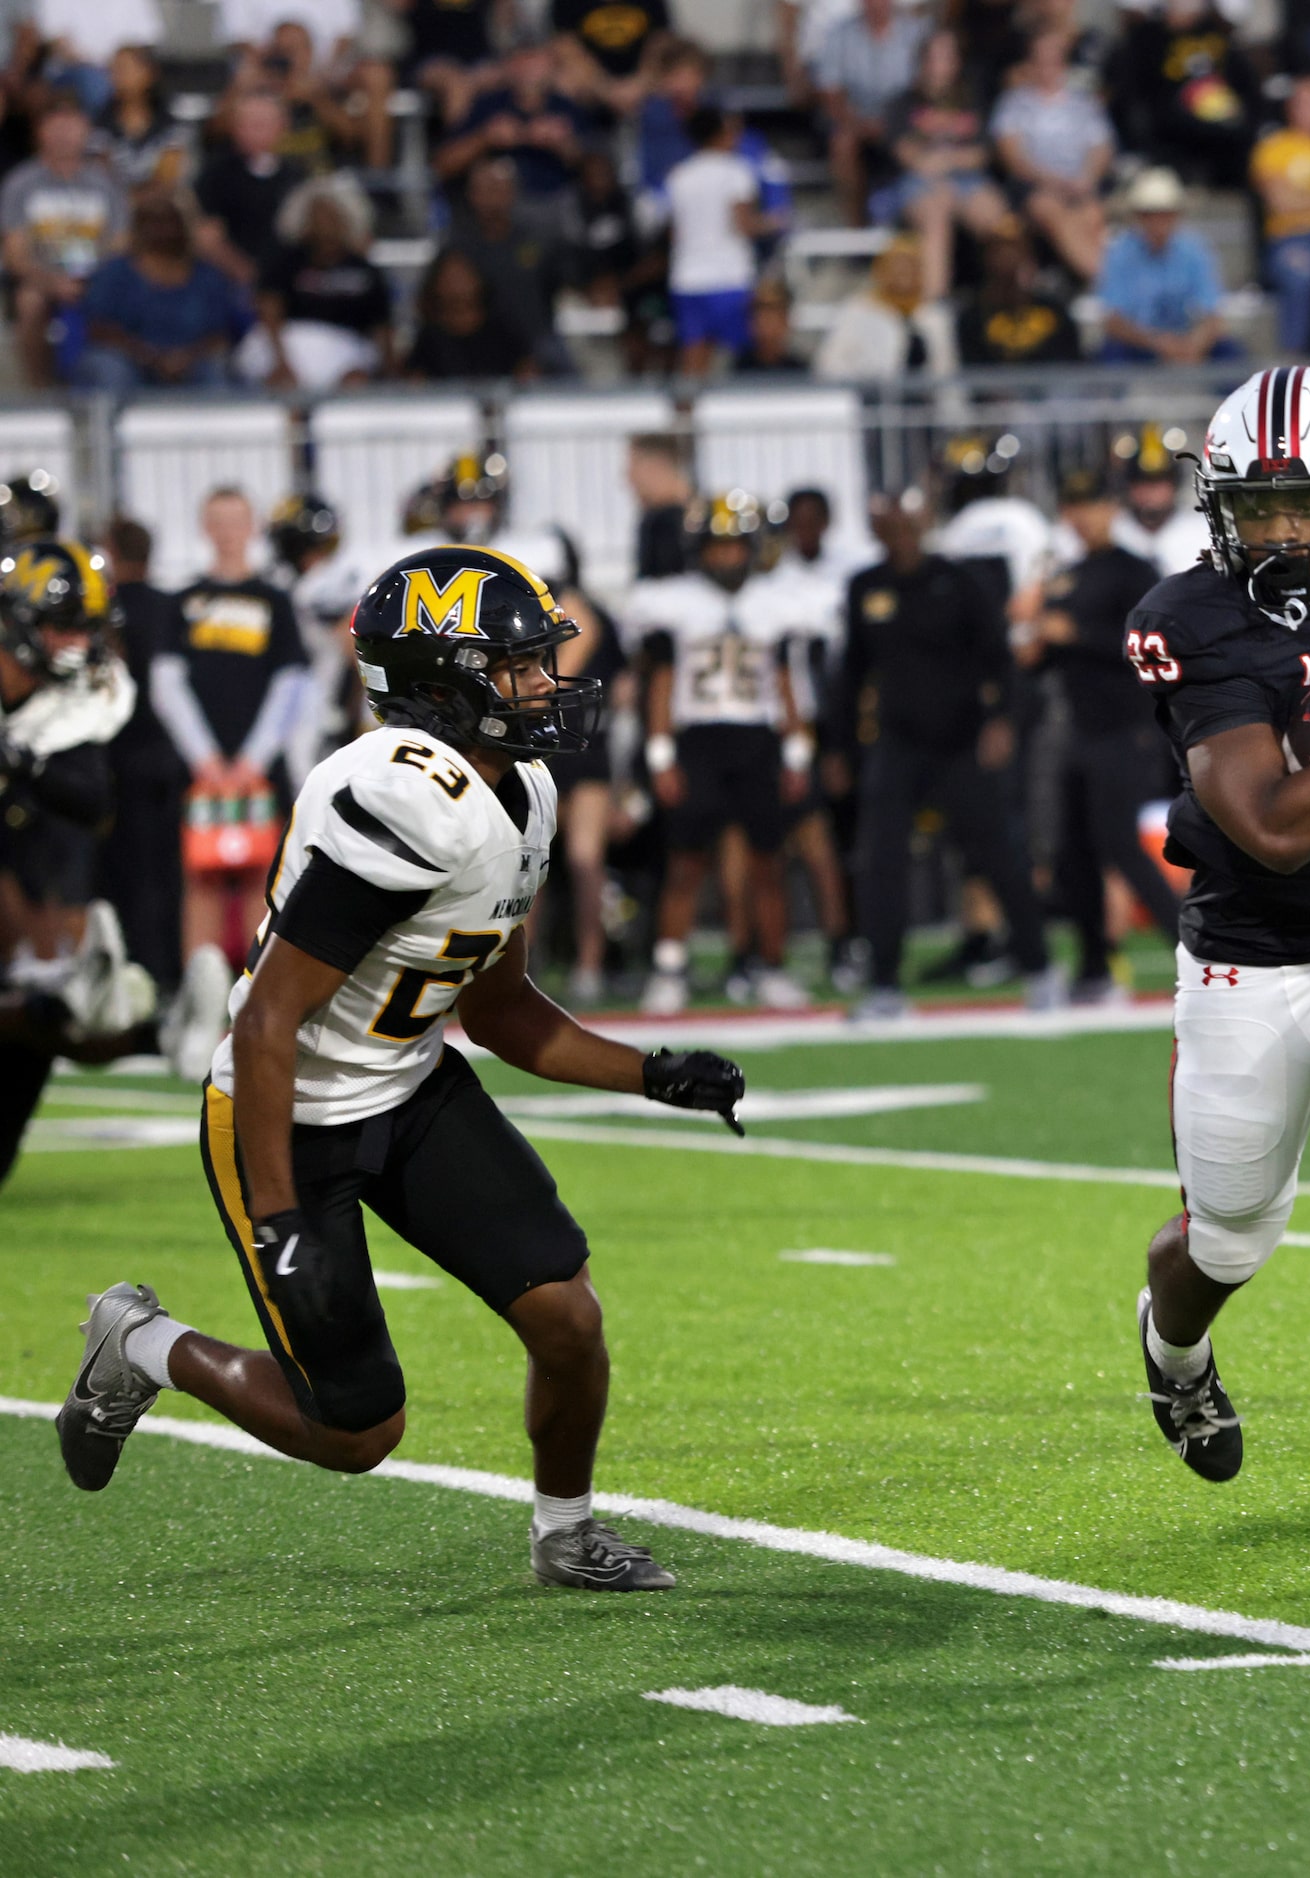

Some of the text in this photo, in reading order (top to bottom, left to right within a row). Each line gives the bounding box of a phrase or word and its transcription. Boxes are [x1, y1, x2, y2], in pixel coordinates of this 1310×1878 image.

[392, 567, 499, 640] M
[1126, 629, 1184, 685] 23
[390, 738, 471, 803] 23
